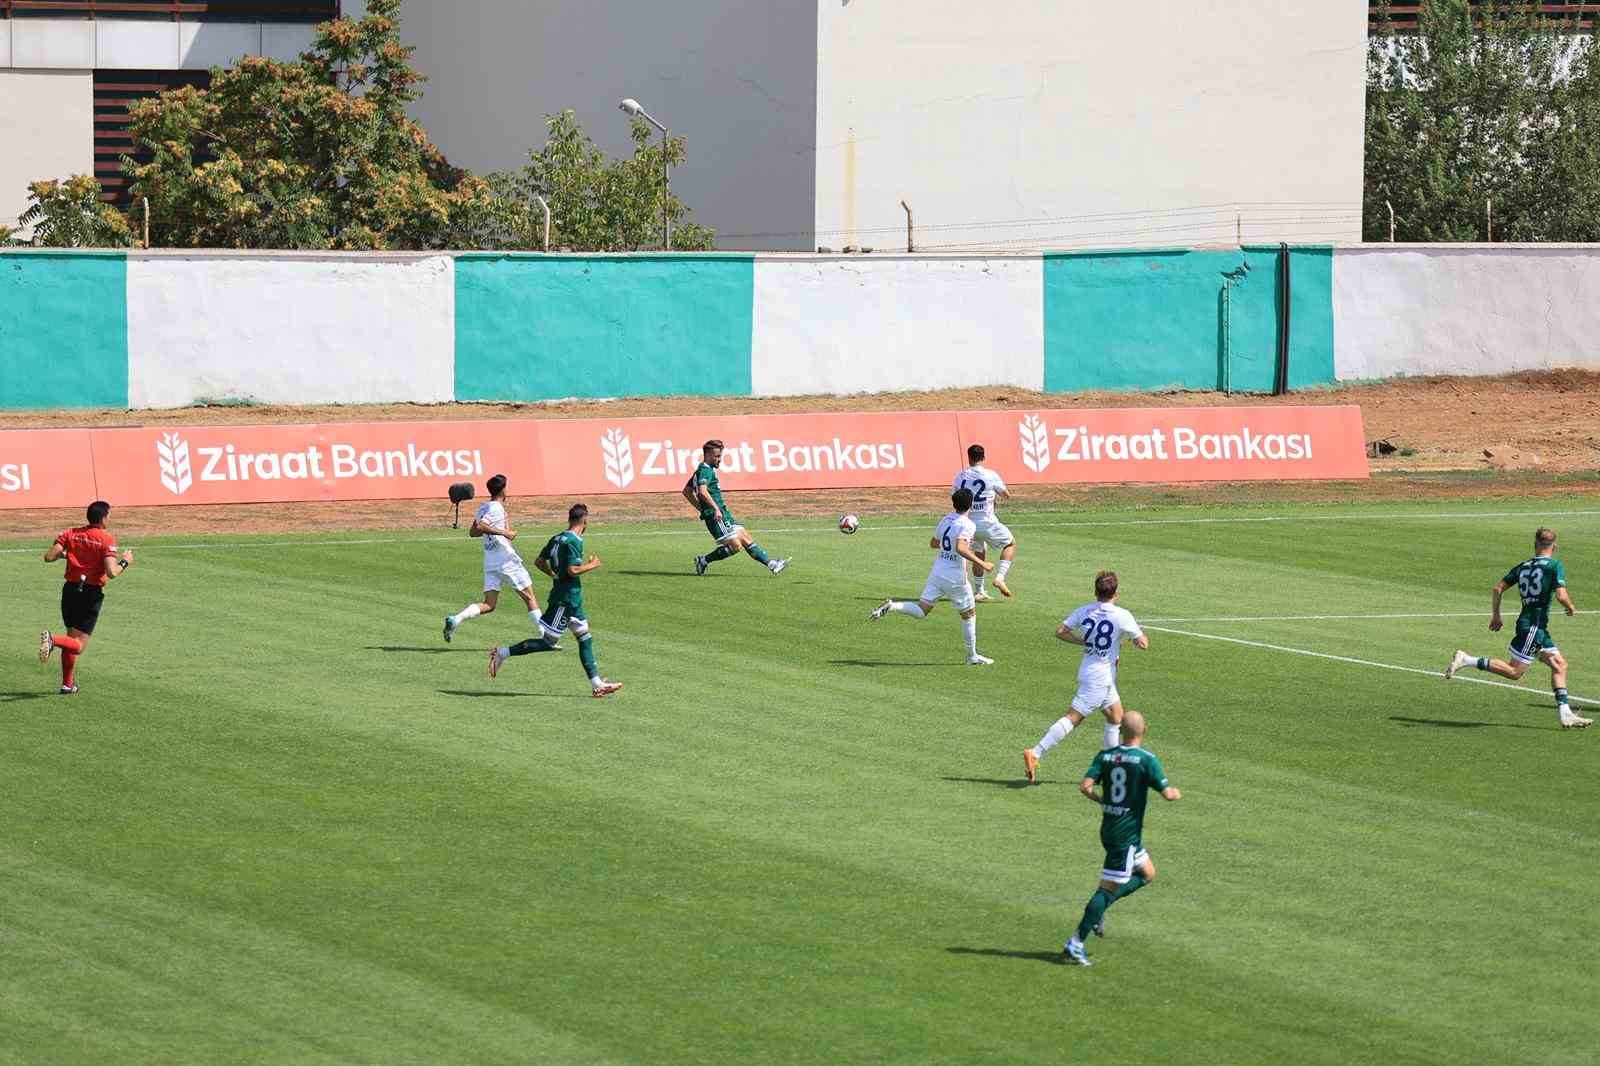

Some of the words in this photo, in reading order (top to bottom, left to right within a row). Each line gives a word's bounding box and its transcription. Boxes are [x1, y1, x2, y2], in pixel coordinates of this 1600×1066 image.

[761, 436, 906, 473] Bankası
[1055, 425, 1168, 461] Ziraat
[1173, 426, 1313, 460] Bankası
[198, 444, 325, 481] Ziraat
[330, 442, 485, 479] Bankası
[942, 526, 951, 552] 6
[1081, 617, 1114, 650] 28
[1110, 766, 1127, 804] 8
